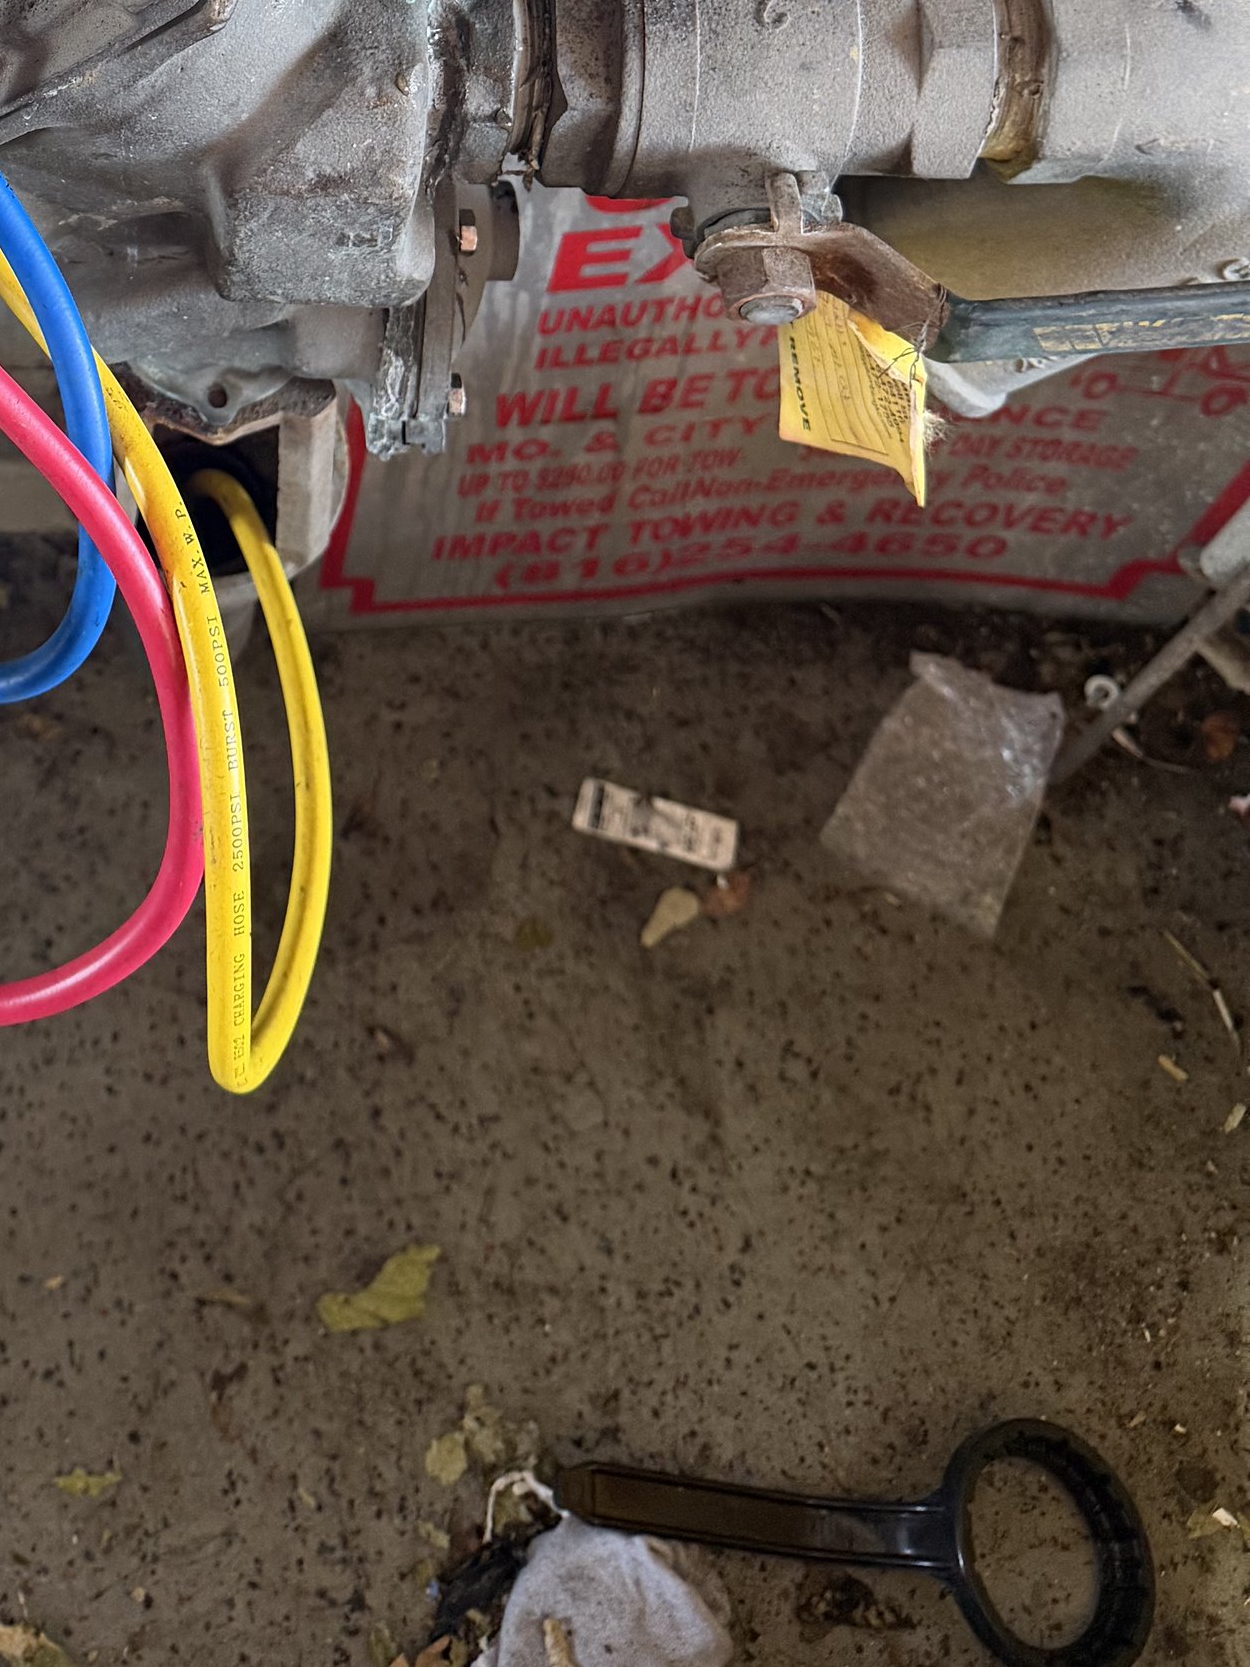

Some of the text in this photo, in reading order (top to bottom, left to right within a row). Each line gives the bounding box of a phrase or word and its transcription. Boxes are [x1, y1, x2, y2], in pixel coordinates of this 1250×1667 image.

[537, 291, 727, 337] UNAUTHO
[535, 327, 754, 373] ILLEGALLY
[495, 381, 620, 429] WILL
[638, 372, 715, 416] BE
[789, 337, 812, 431] REMOVE
[465, 437, 563, 465] MO.
[643, 412, 774, 449] CITY
[1005, 436, 1140, 472] STORAGE
[457, 472, 491, 499] UP
[497, 468, 530, 494] TO
[633, 452, 681, 480] FOR
[690, 447, 741, 473] TOW
[513, 490, 617, 521] Towed
[961, 462, 1068, 496] Police
[431, 497, 1135, 560] IMPACT TOWING & RECOVERY
[192, 550, 210, 594] MAX.
[207, 616, 229, 687] 500PSI
[222, 710, 236, 772] BURST
[230, 794, 244, 873] 2500PSI
[233, 890, 245, 937] HOSE
[233, 952, 245, 1027] CHARGING
